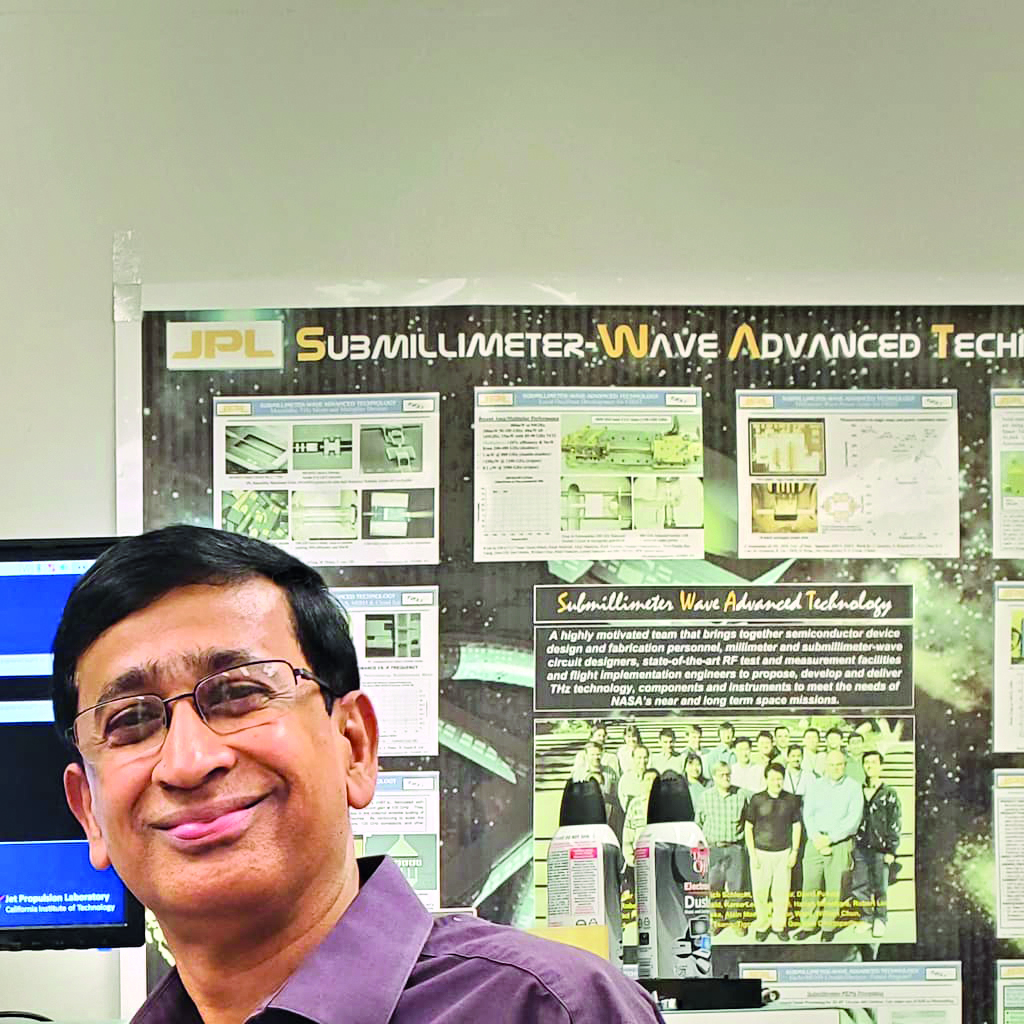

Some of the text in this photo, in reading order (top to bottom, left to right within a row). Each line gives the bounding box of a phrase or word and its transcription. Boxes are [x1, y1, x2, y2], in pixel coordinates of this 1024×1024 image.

[172, 329, 275, 360] JPL
[728, 323, 921, 360] ADVANCED
[557, 589, 892, 617] Submillimeter Wave Advanced Technology
[549, 627, 901, 642] A highly motivated team that brings together semiconductor device
[546, 640, 904, 656] design and fabrication personnel, millimeter and submillimeter-wave
[547, 654, 901, 669] circuit designers, state-of-the-art RF test and measurement facilities
[546, 667, 903, 682] and flight implementation engineers to propose, develop and deliver
[550, 680, 901, 694] THz technology, components and instruments to meet the needs of
[610, 694, 840, 708] NASA's near and long term space missions.
[4, 891, 110, 905] Jet Propulsion Laboratory
[5, 902, 115, 914] California Institute Technology
